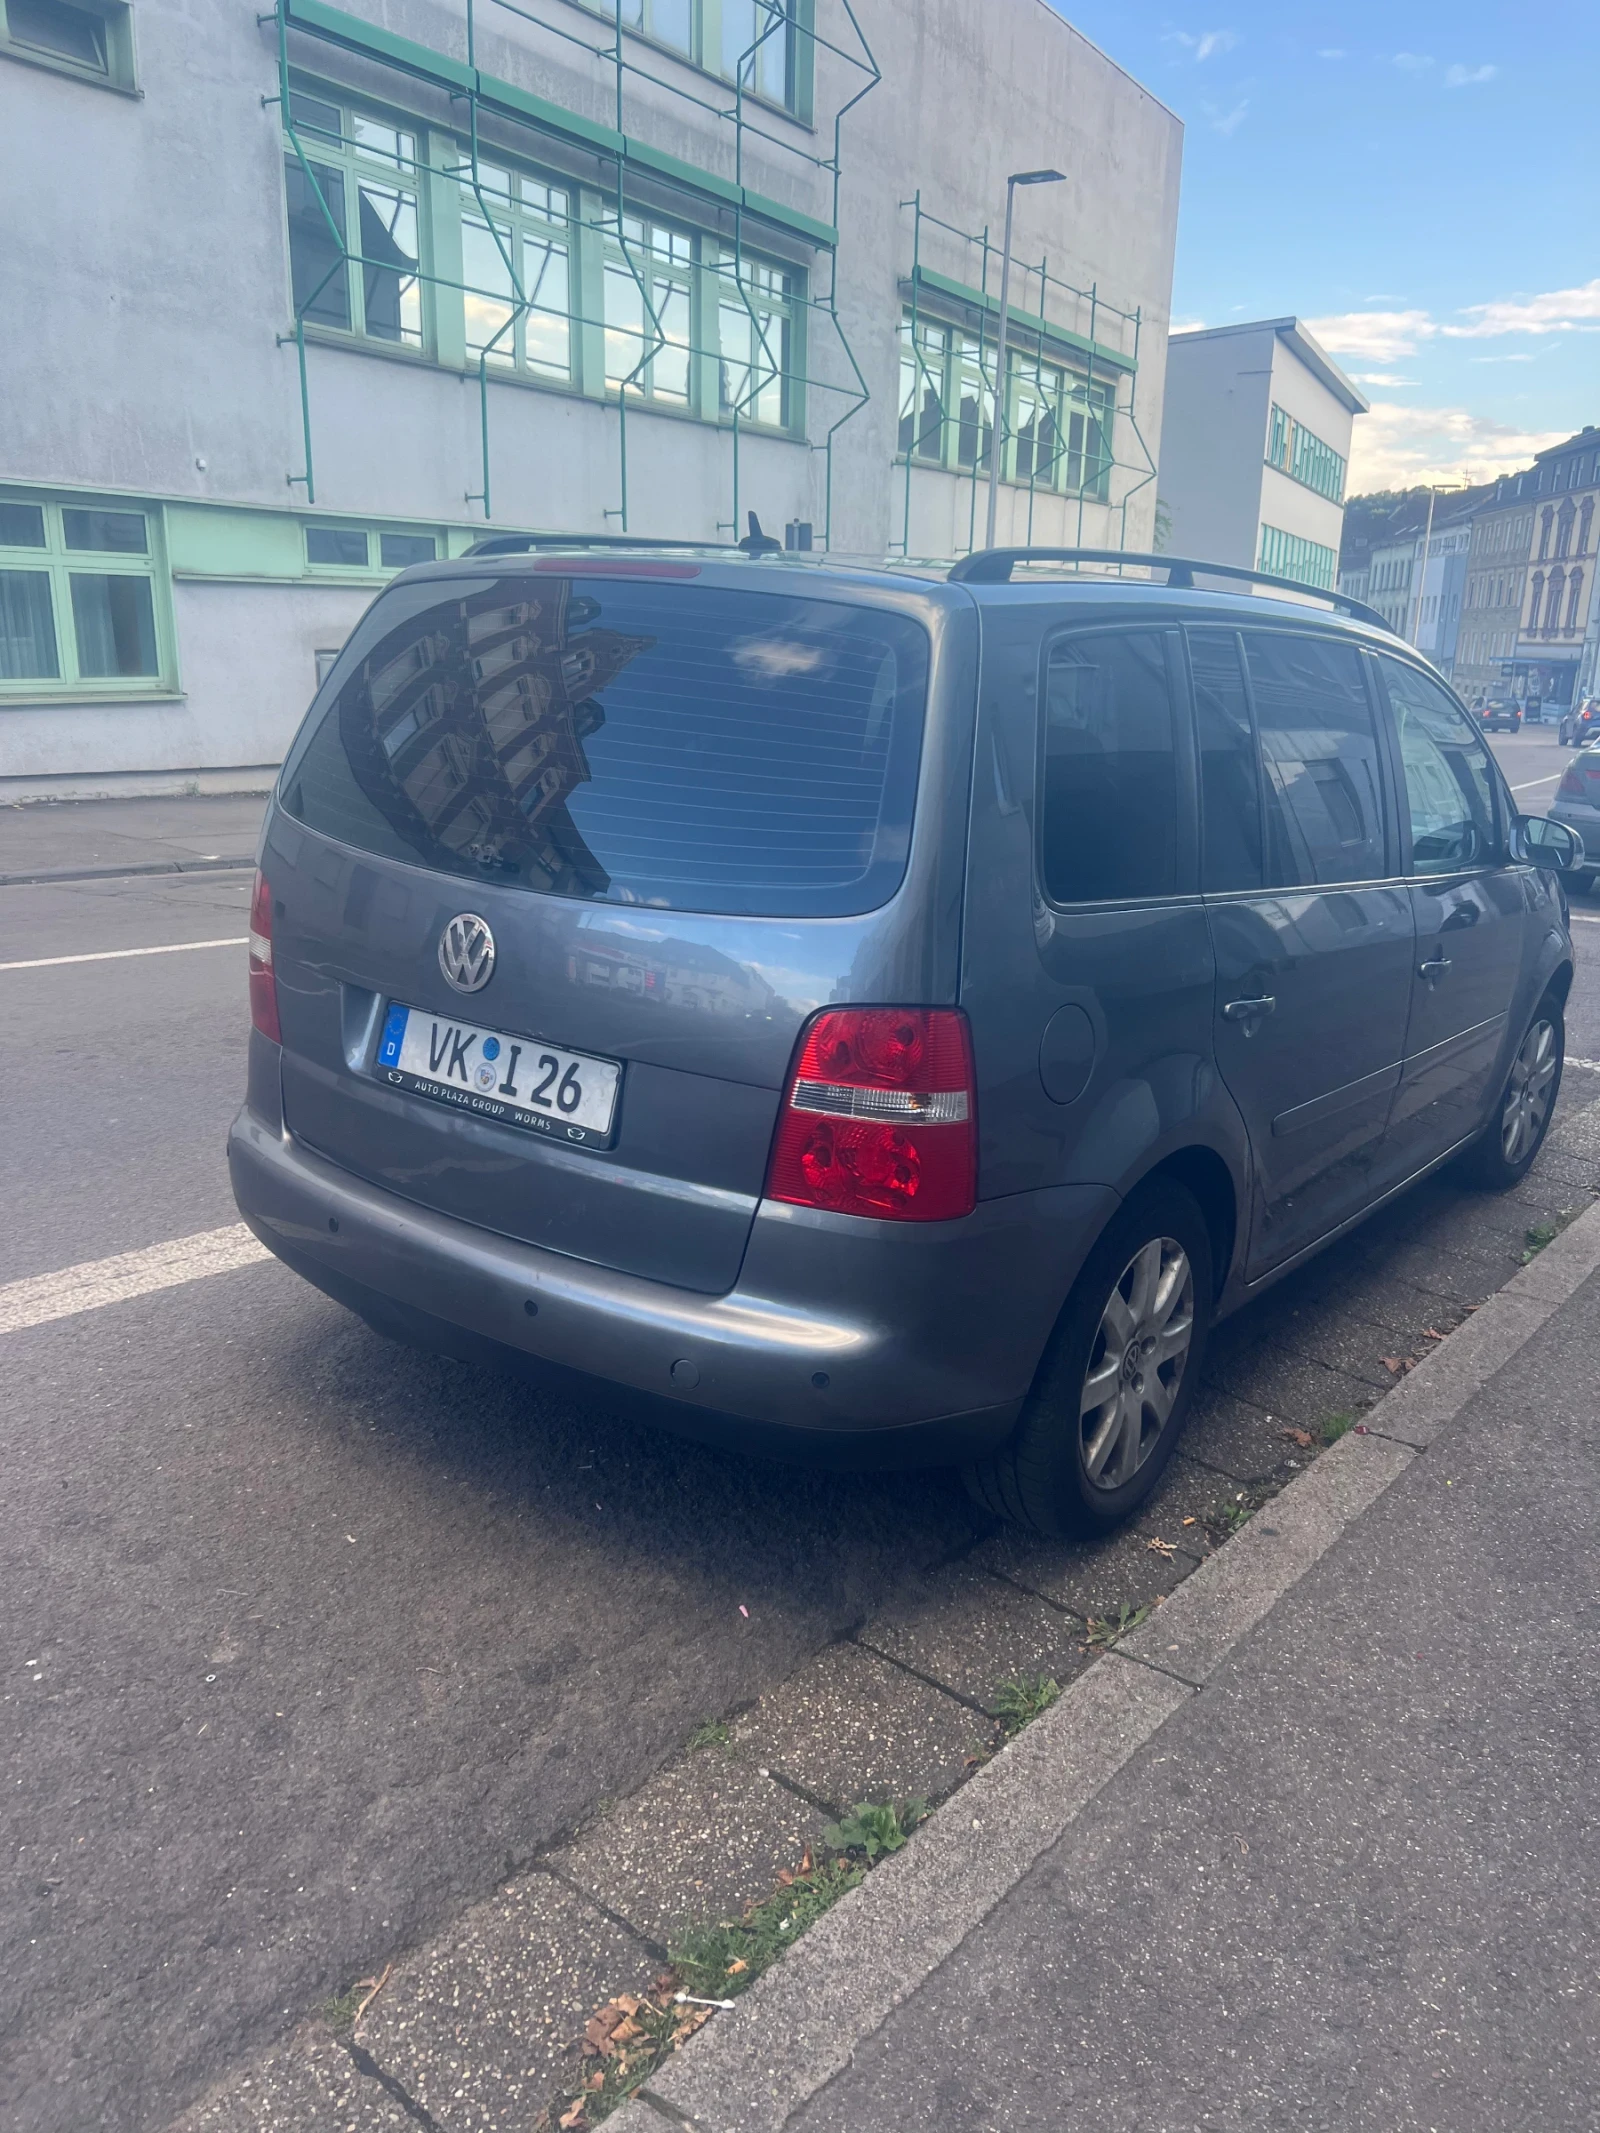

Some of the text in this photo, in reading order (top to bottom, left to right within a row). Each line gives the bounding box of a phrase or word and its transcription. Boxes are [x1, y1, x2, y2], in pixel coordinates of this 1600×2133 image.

[438, 913, 495, 993] VW
[386, 1042, 395, 1056] D
[429, 1022, 582, 1113] VK I 26
[414, 1081, 551, 1130] AUTO PLAZA GROUP WORMS
